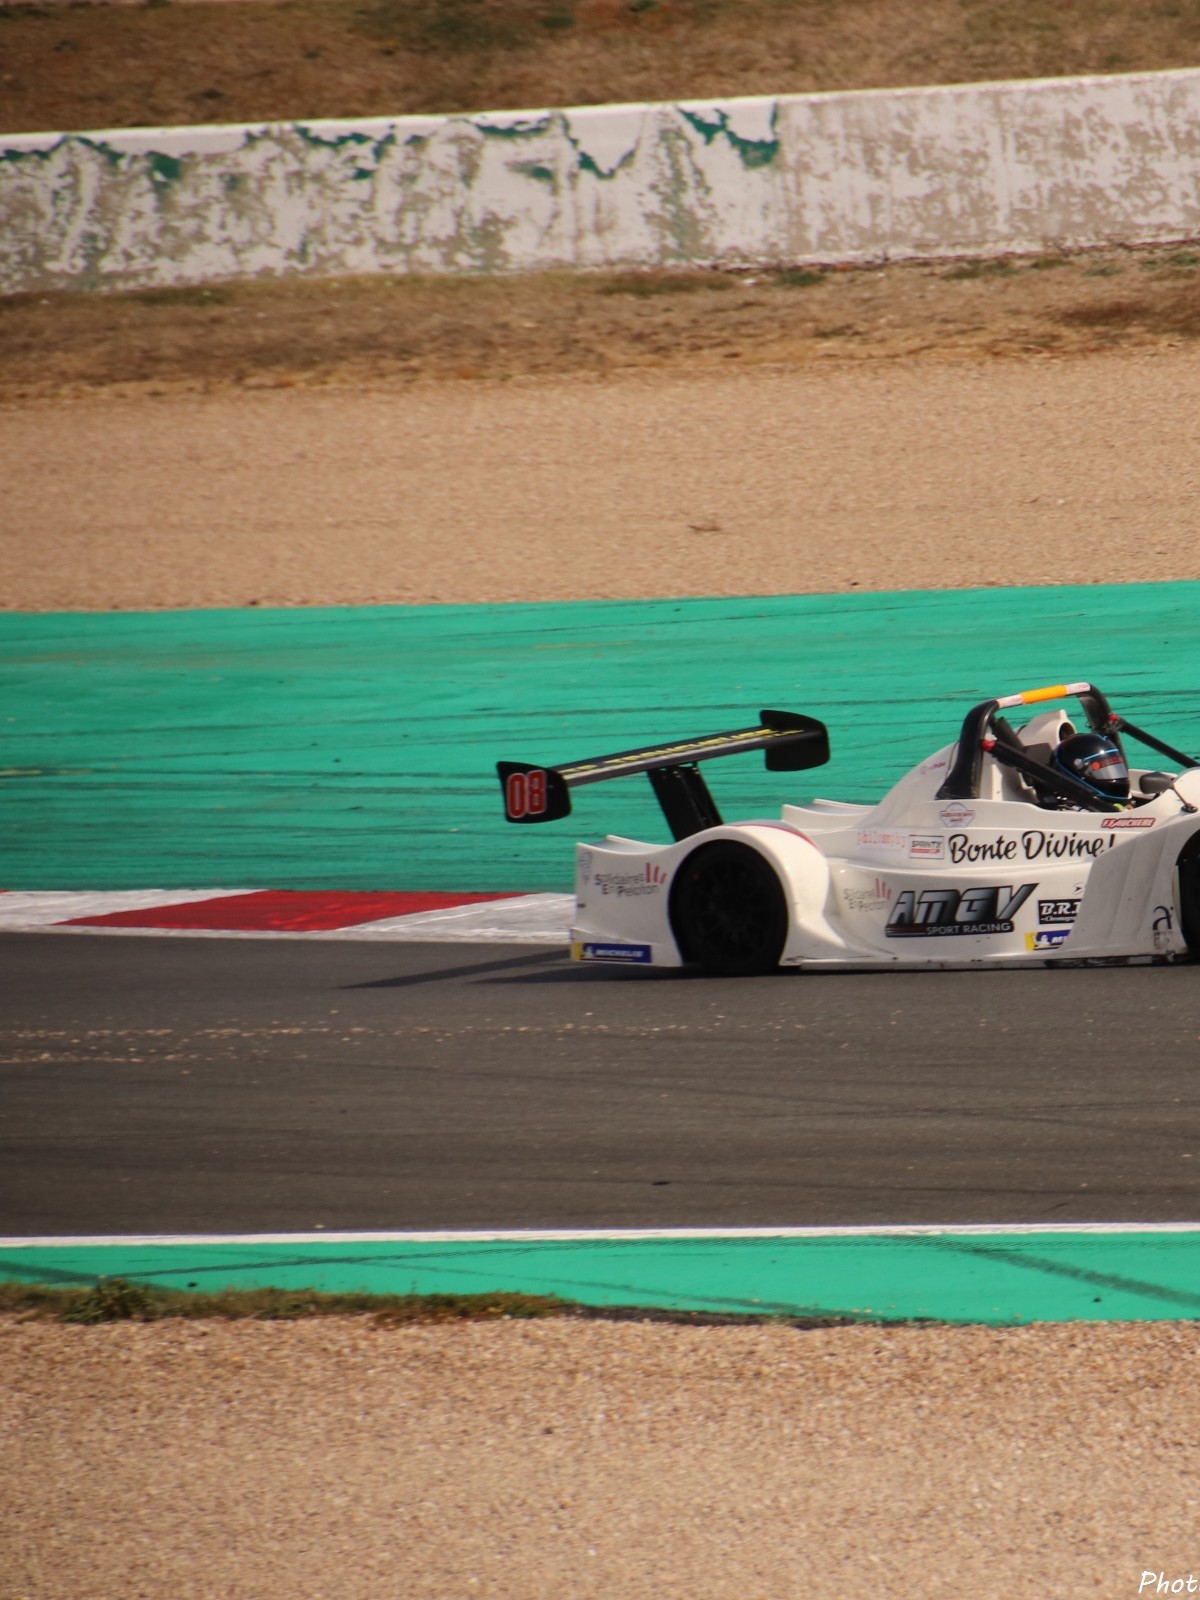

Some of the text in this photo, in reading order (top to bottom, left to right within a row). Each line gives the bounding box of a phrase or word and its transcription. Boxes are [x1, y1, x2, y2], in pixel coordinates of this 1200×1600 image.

[506, 769, 548, 818] 08
[949, 830, 1116, 864] Bonte Divine!
[927, 922, 1010, 936] SPORT RACING
[595, 949, 644, 958] MICHELIN
